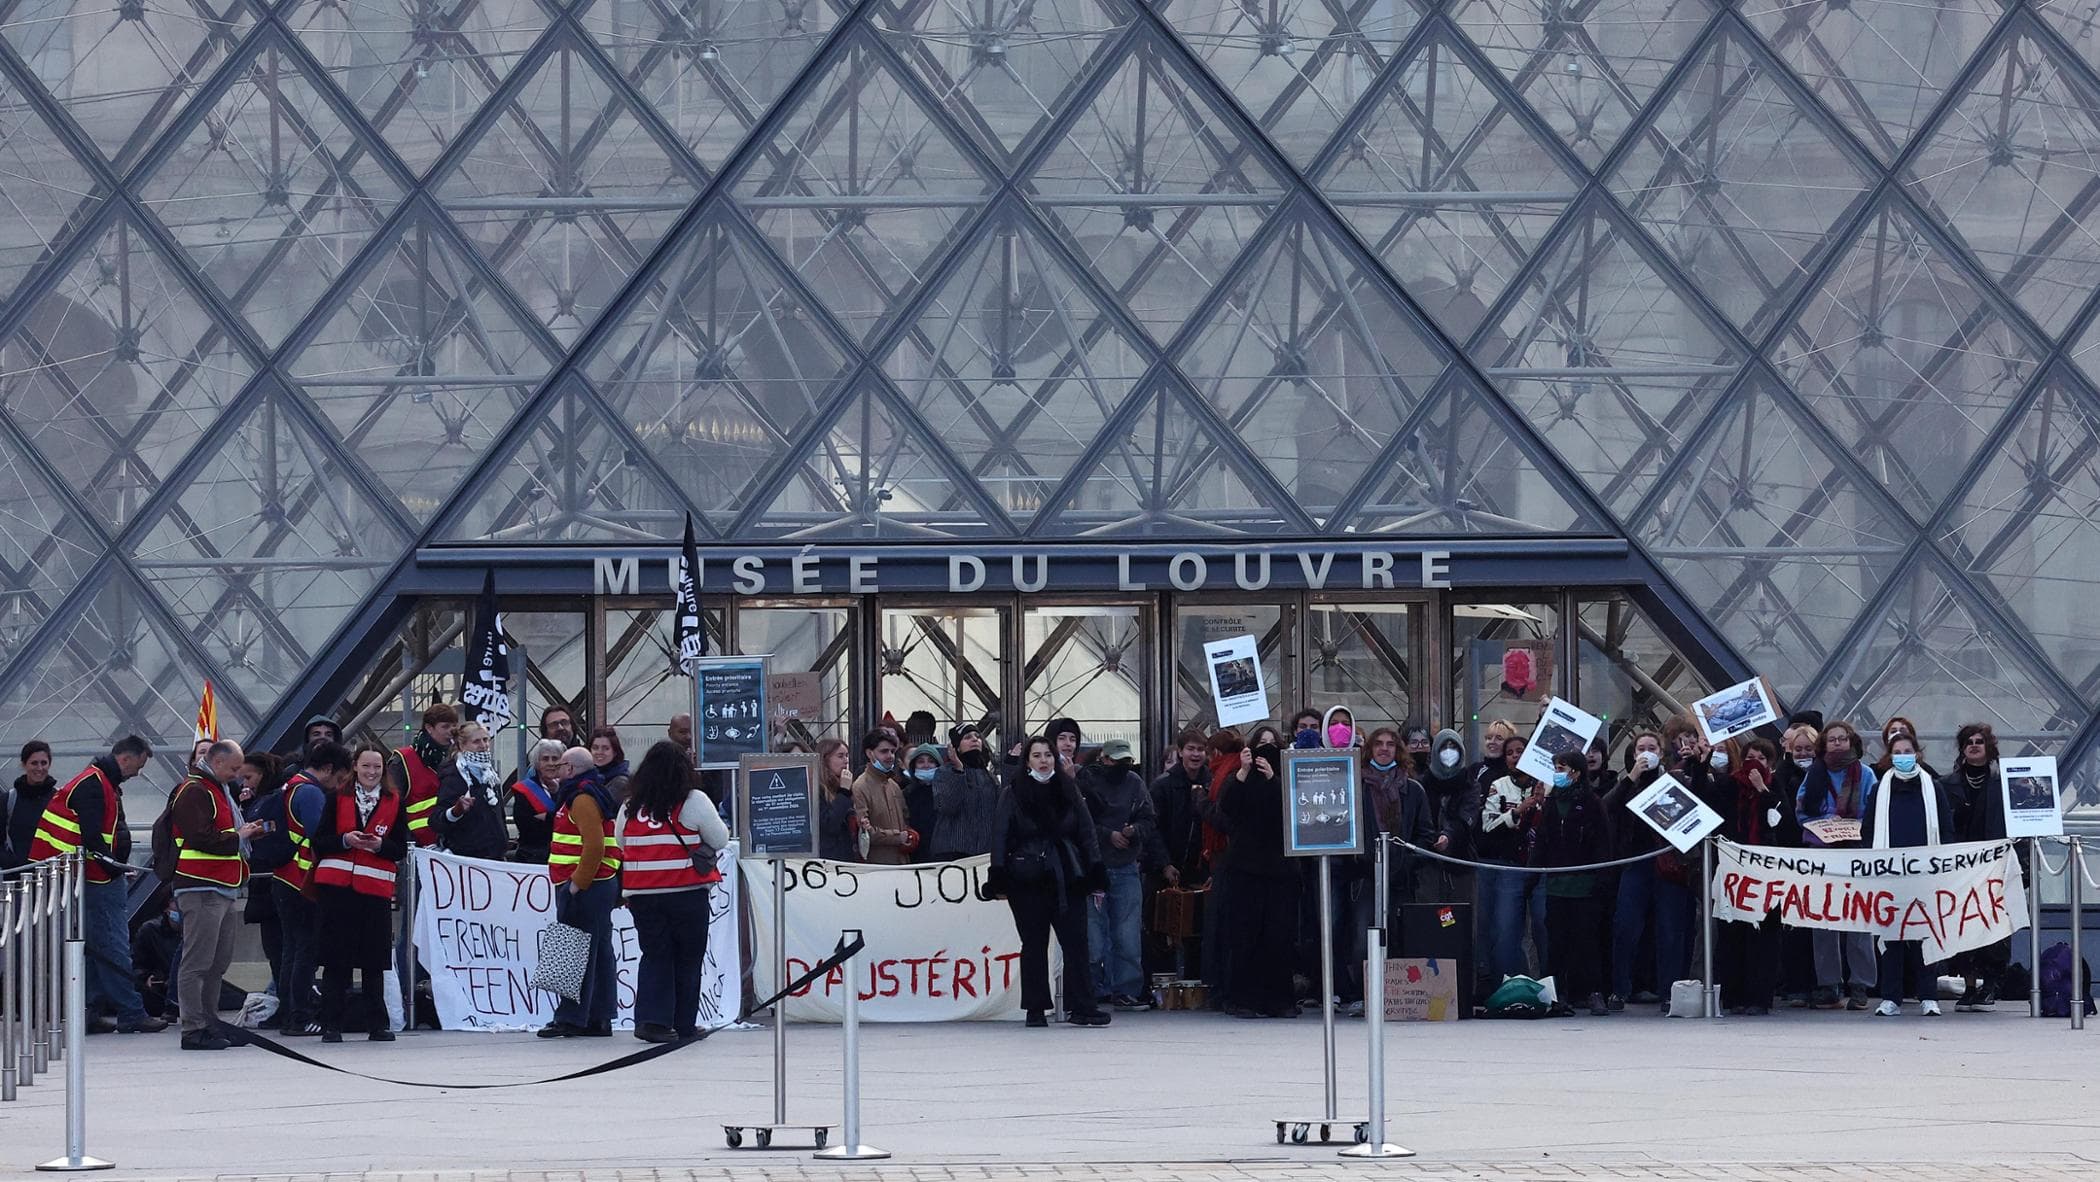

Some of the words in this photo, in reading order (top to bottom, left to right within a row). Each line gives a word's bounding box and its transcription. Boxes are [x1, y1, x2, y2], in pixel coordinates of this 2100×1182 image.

[593, 543, 880, 595] MUSÉE
[948, 553, 1048, 593] DU
[1118, 550, 1451, 591] LOUVRE
[429, 857, 492, 911] DID
[506, 871, 551, 912] YO
[895, 864, 1003, 909] JOU
[1739, 849, 1825, 876] FRENCH
[437, 917, 519, 961] FRENCH
[1900, 878, 2009, 952] APAR
